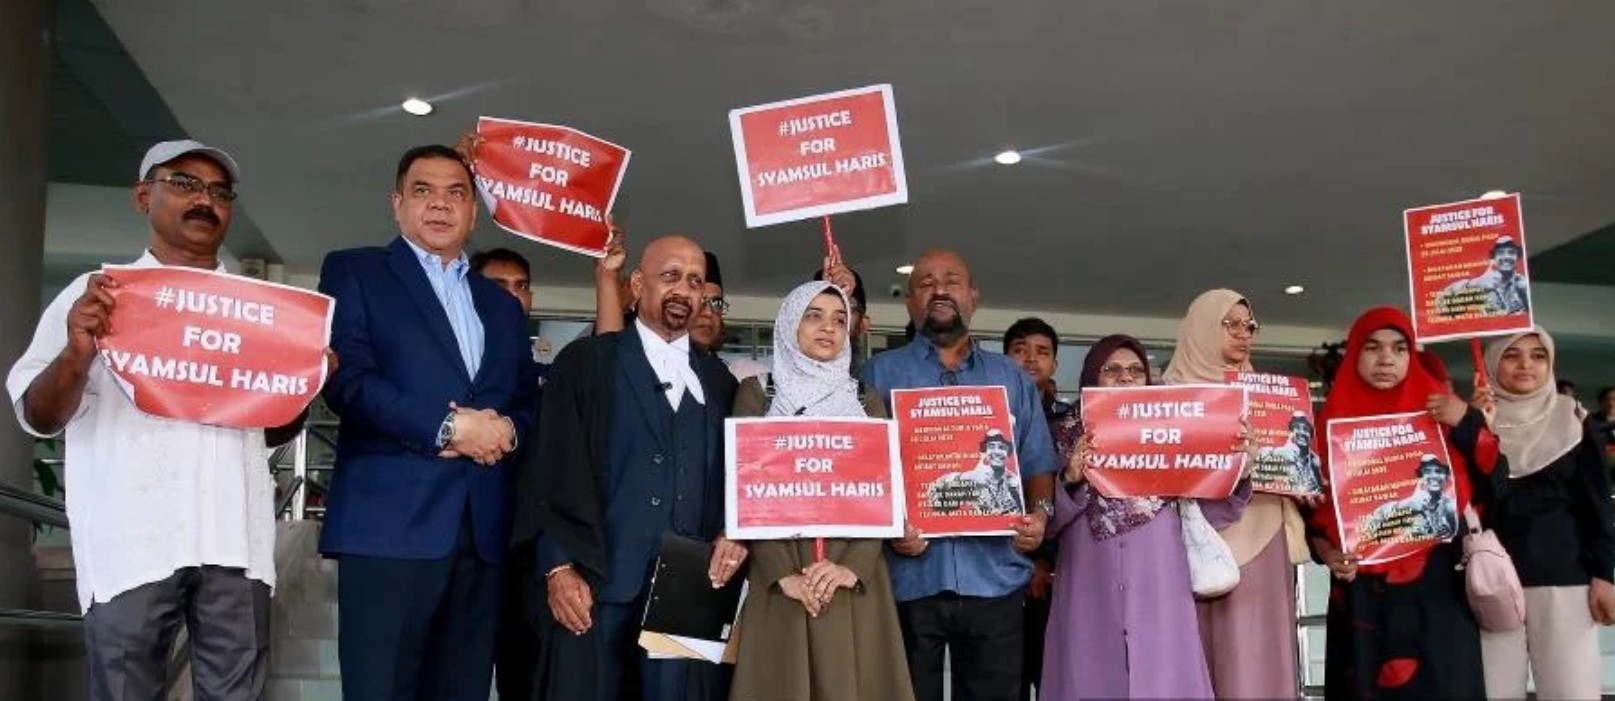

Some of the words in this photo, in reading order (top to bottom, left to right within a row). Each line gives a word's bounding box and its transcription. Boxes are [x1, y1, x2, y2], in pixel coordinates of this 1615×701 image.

[779, 110, 851, 136] #JUSTICE
[513, 135, 590, 167] #JUSTICE
[800, 138, 835, 156] FOR
[529, 163, 568, 187] FOR
[757, 163, 832, 187] SYAMSUL
[835, 152, 887, 173] HARIS
[1430, 210, 1471, 224] JUSTICE
[1472, 206, 1493, 218] FOR
[1421, 220, 1471, 235] SYAMSUL
[1472, 215, 1504, 228] HARIS
[154, 287, 275, 324] #JUSTICE
[183, 326, 241, 354] FOR
[231, 368, 308, 396] HARIS
[918, 395, 960, 408] JUSTICE
[961, 395, 981, 405] FOR
[1117, 402, 1205, 418] #JUSTICE
[910, 407, 960, 418] SYAMSUL
[961, 405, 993, 416] HARIS
[1140, 428, 1181, 444] FOR
[1352, 427, 1390, 440] JUSTICE
[1391, 423, 1413, 435] FOR
[774, 434, 854, 450] #JUSTICE
[795, 458, 833, 473] FOR
[1174, 454, 1233, 470] HARIS
[745, 482, 826, 498] SYAMSUL
[831, 482, 884, 497] HARIS
